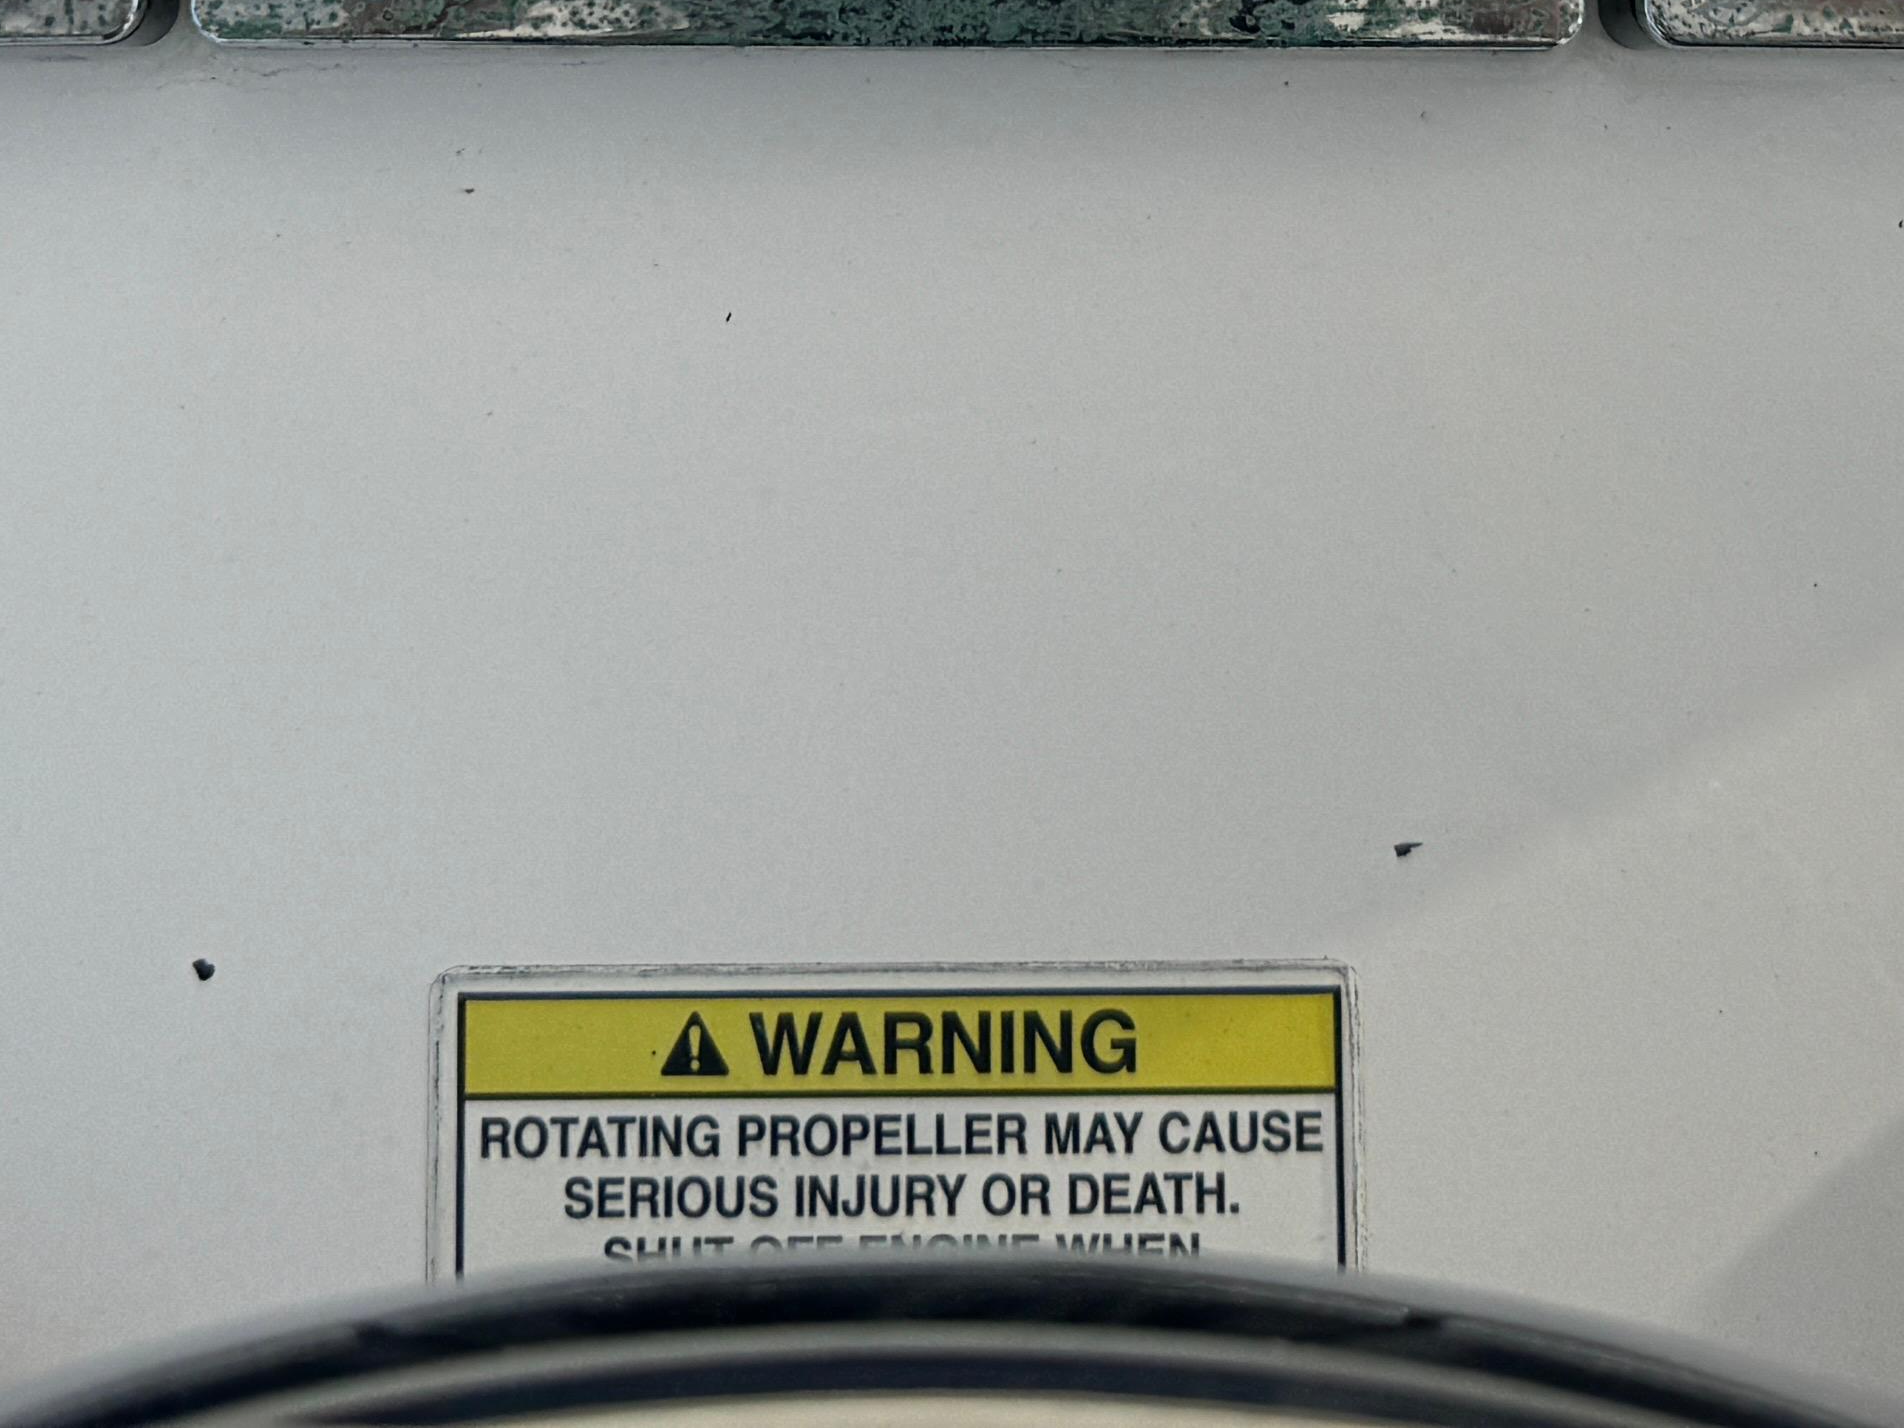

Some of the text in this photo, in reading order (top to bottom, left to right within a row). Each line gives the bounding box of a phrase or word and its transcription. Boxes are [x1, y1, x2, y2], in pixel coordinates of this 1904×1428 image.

[748, 1008, 1138, 1076] WARNING
[479, 1110, 1325, 1161] ROTATING PROPELLER MAY CAUSE
[563, 1172, 1241, 1220] SERIOUS INJURY OR DEATH.
